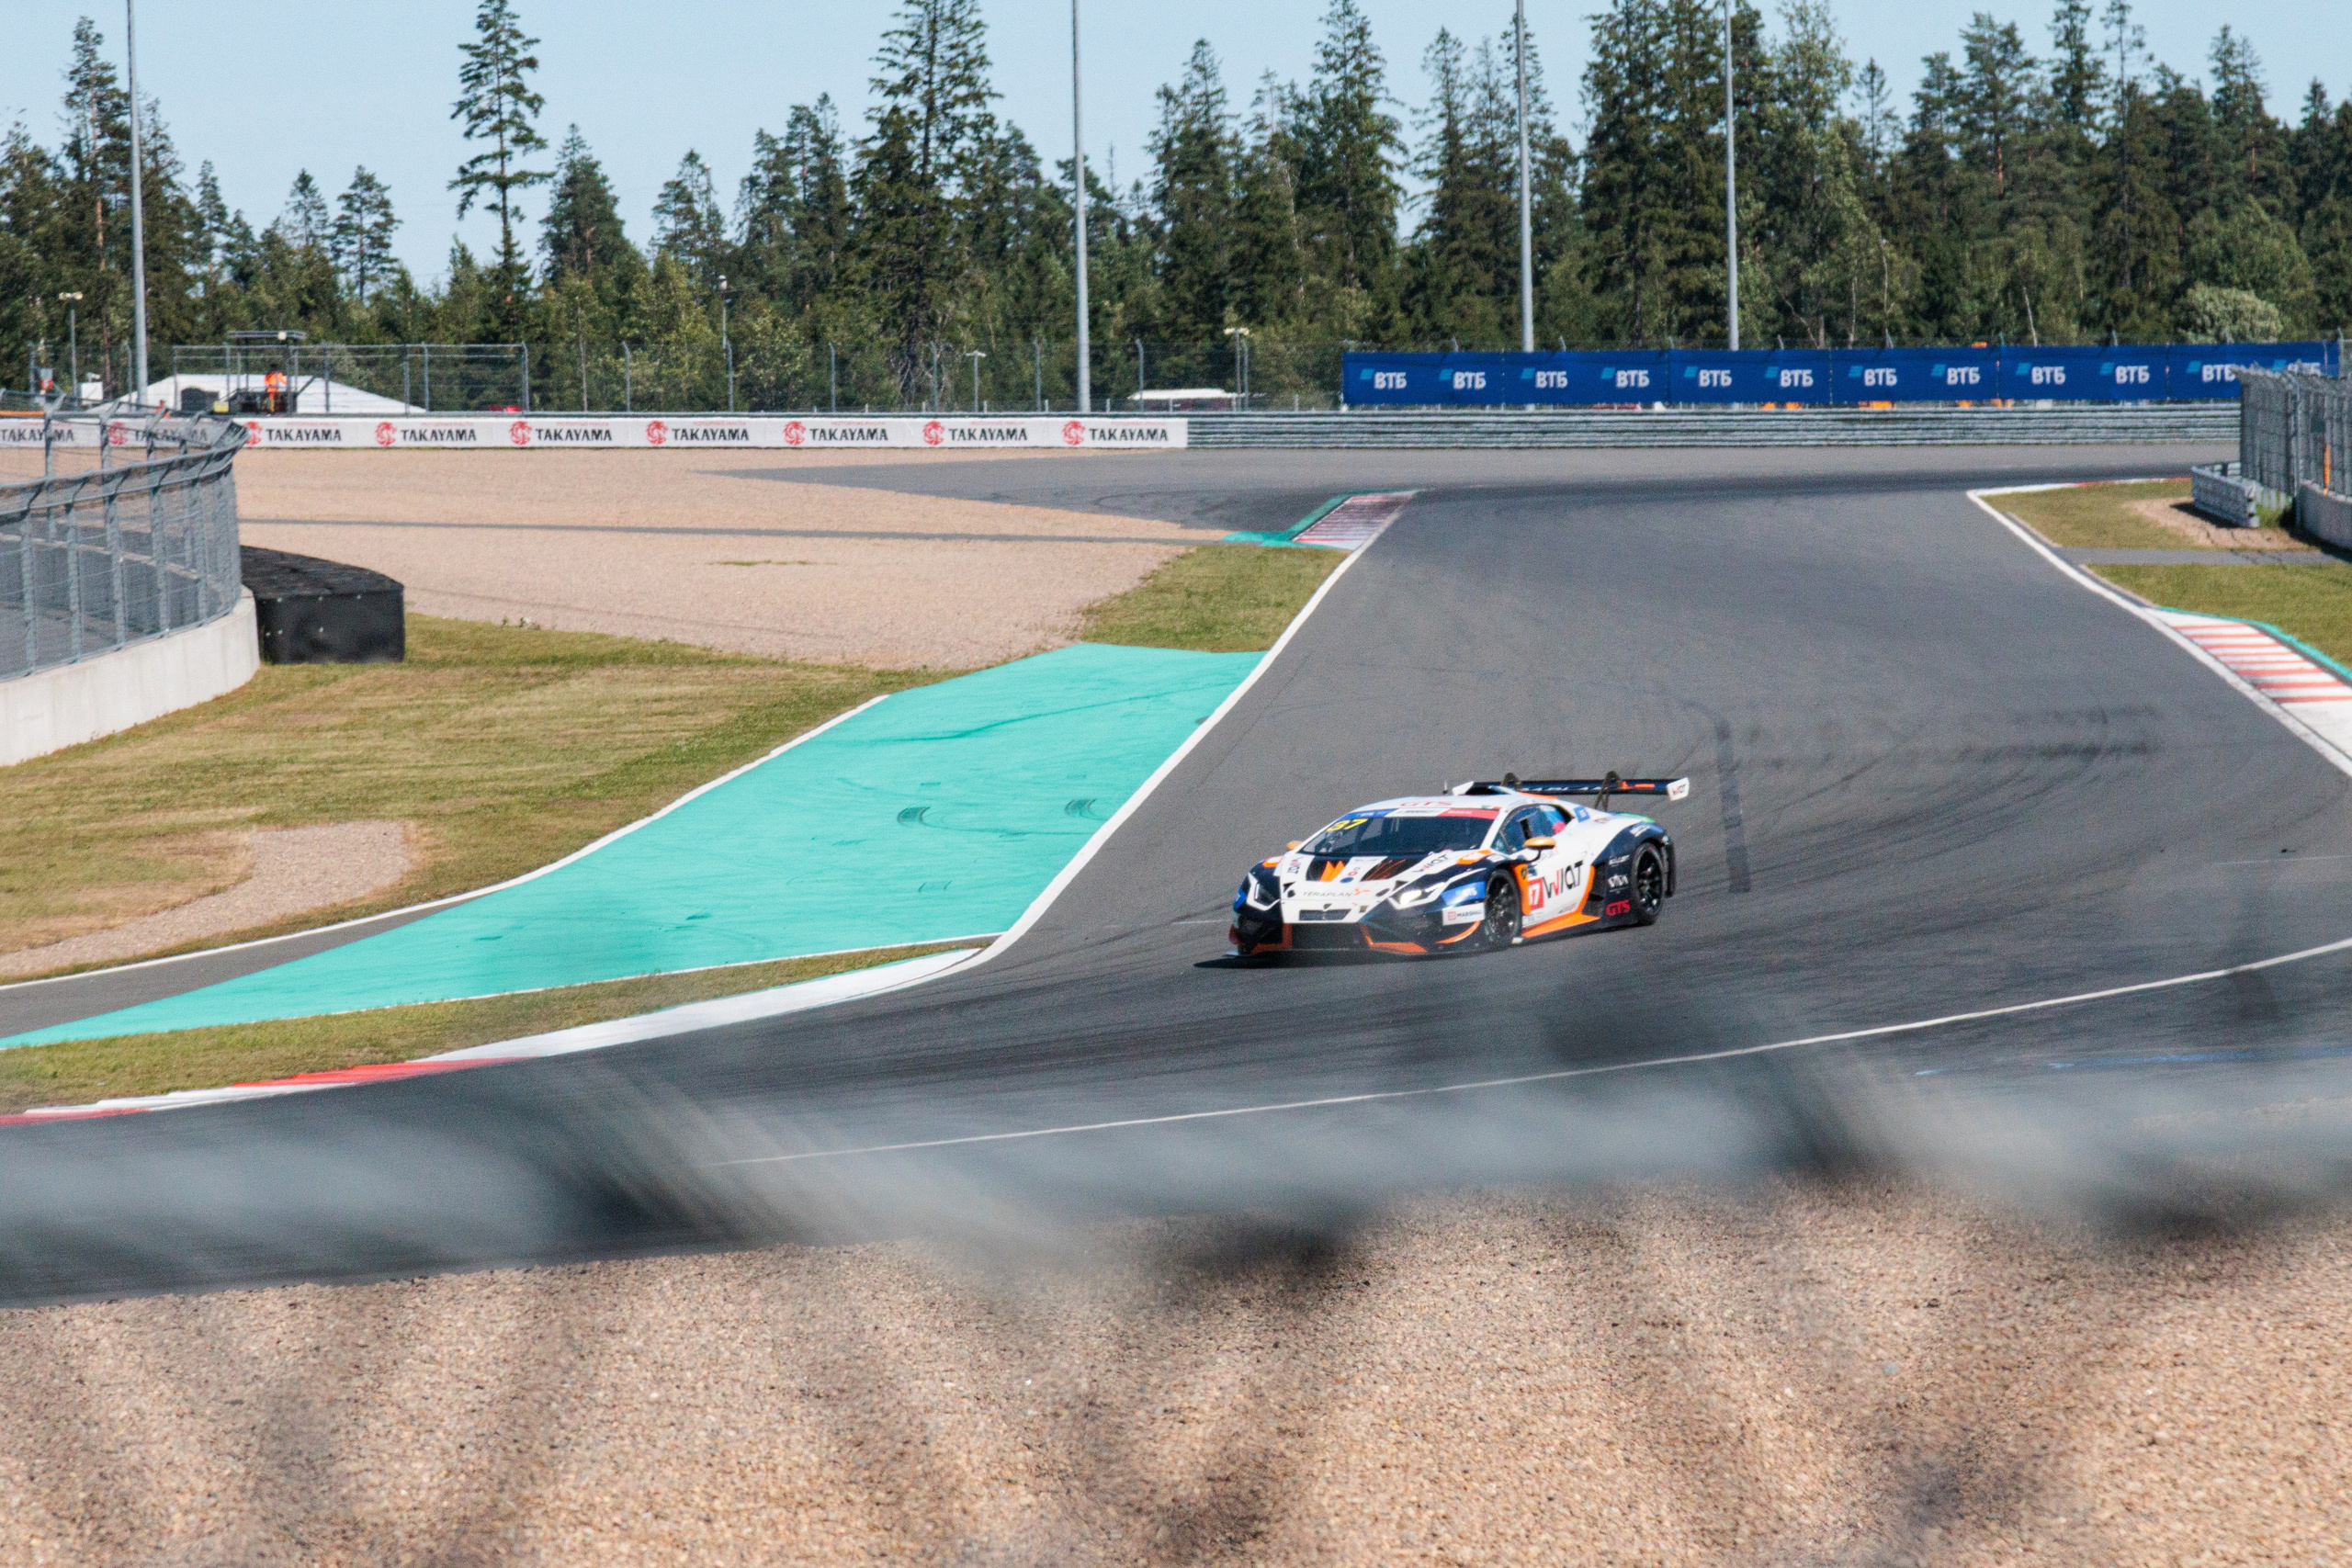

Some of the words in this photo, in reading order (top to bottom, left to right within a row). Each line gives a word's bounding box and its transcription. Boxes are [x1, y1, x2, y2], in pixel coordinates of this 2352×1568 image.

[1374, 372, 1407, 389] ВТБ
[1453, 371, 1487, 389] ВТБ
[1536, 371, 1568, 389] ВТБ
[1616, 369, 1650, 389] ВТБ
[1699, 369, 1732, 387] ВТБ
[1780, 368, 1814, 388] ВТБ
[1864, 367, 1897, 387] ВТБ
[1947, 367, 1981, 385] ВТБ
[2031, 367, 2065, 385] ВТБ
[2115, 366, 2150, 384] ВТБ
[267, 429, 341, 441] TAKAYAMA
[401, 429, 476, 441] TAKAYAMA
[537, 428, 612, 441] TAKAYAMA
[673, 428, 749, 441] TAKAYAMA
[811, 428, 888, 441] TAKAYAMA
[950, 428, 1028, 441] TAKAYAMA
[1091, 428, 1168, 441] TAKAYAMA
[1605, 899, 1631, 917] GTS
